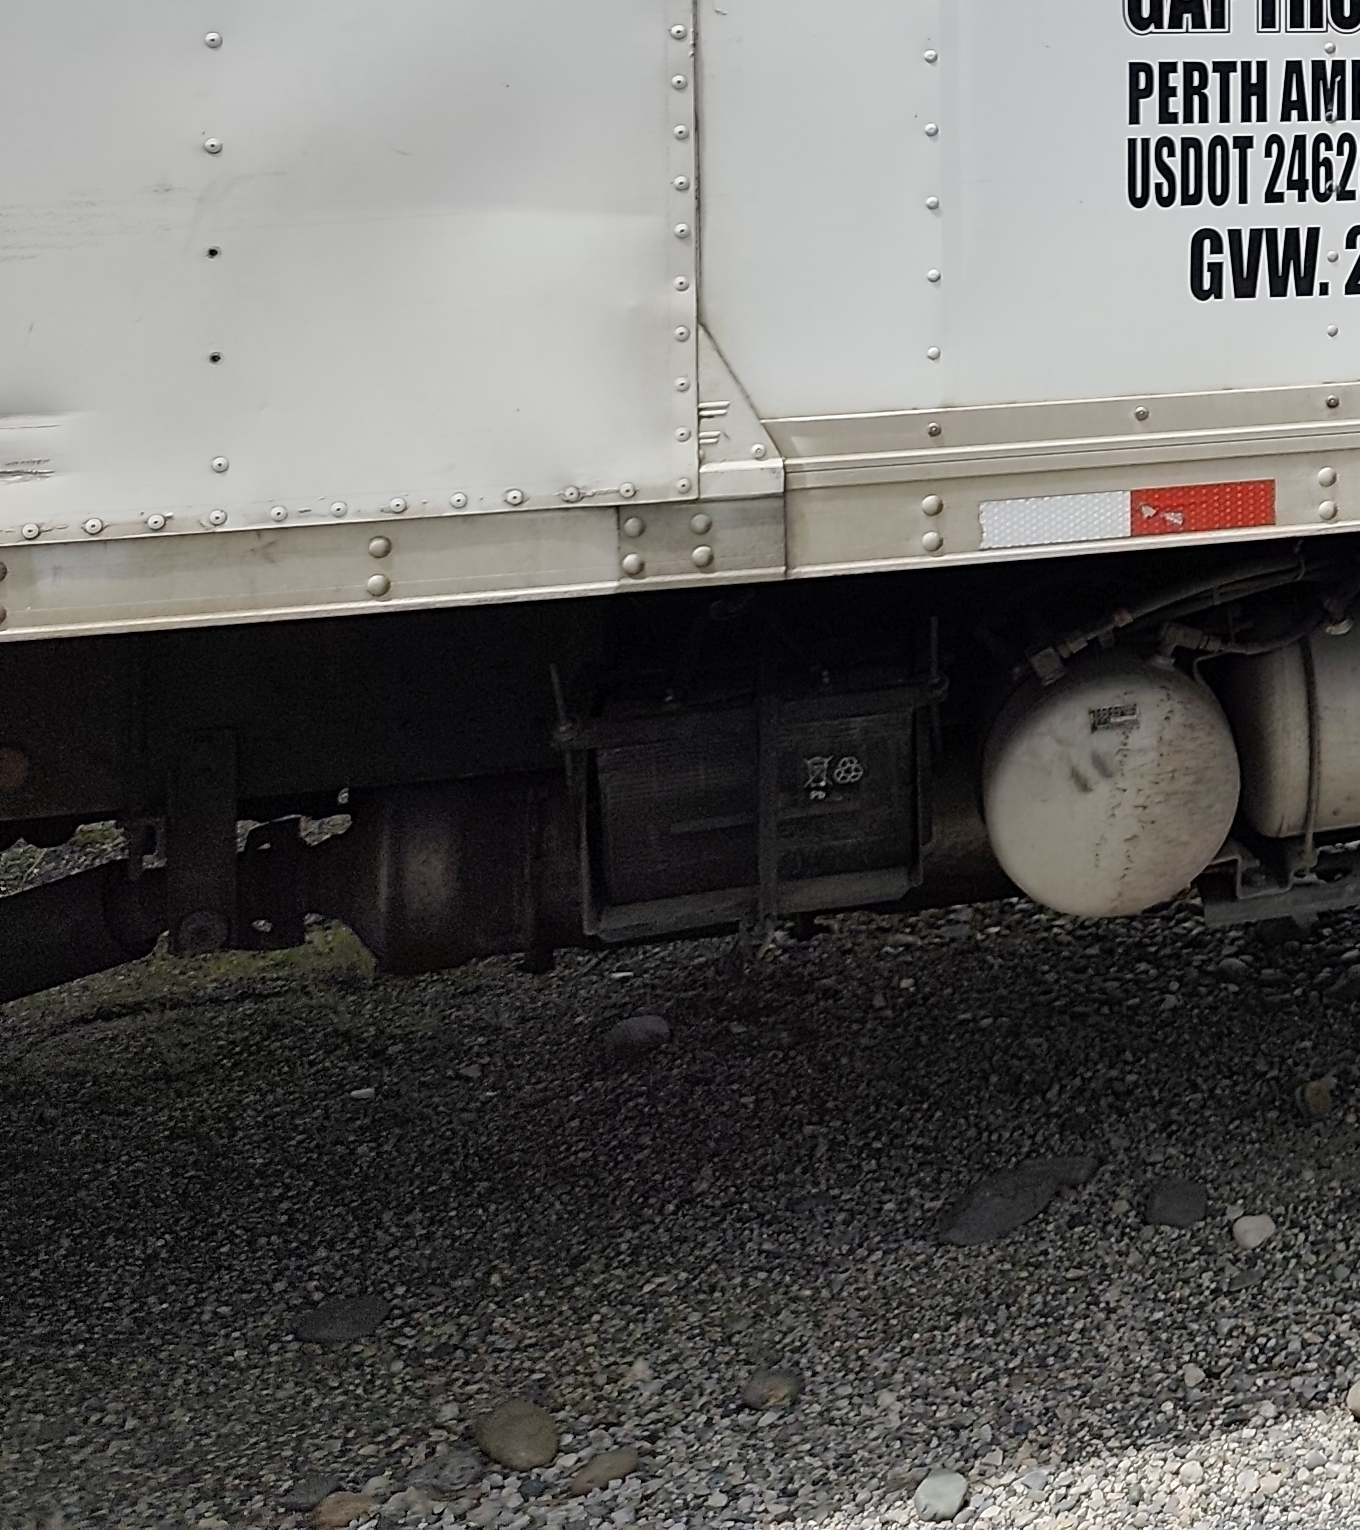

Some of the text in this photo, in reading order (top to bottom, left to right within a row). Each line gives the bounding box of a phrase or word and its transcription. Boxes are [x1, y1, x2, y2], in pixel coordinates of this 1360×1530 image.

[1128, 60, 1268, 125] PERTH
[1127, 135, 1254, 207] USDOT
[1190, 226, 1330, 301] GVW.
